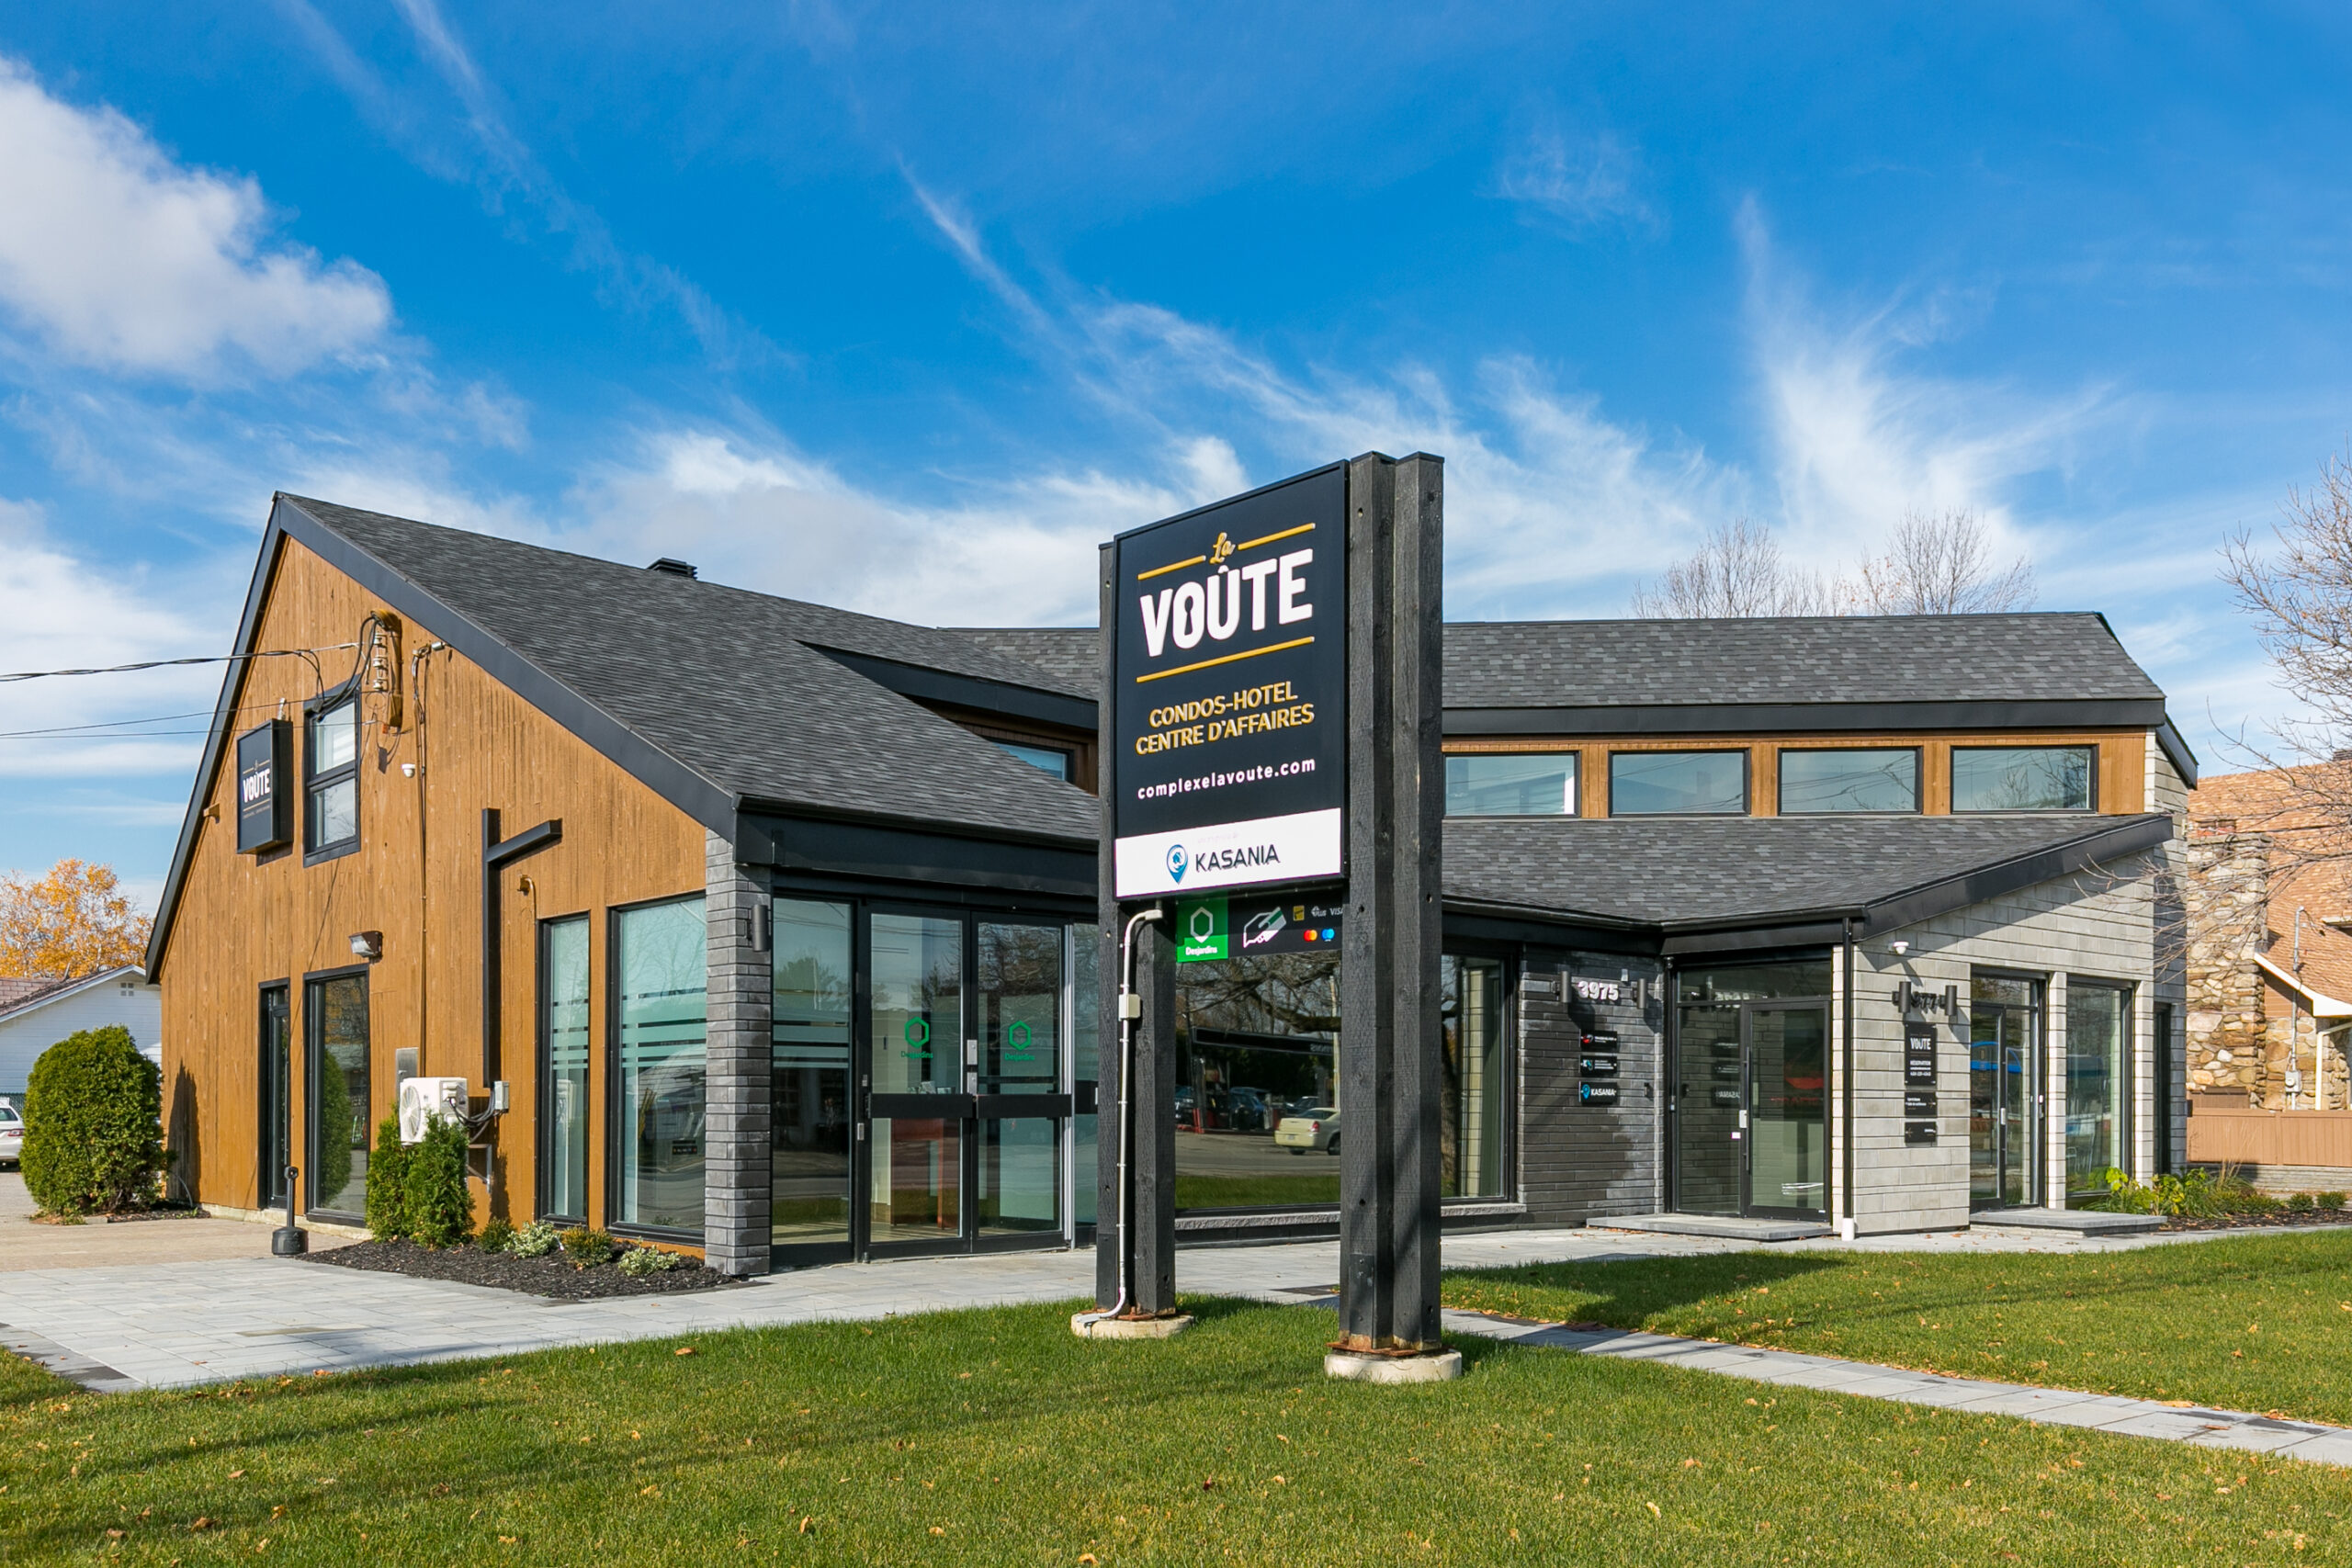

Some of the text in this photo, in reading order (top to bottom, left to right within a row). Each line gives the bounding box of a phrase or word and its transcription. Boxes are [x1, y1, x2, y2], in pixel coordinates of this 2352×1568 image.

[1209, 532, 1236, 564] La
[1139, 547, 1313, 657] VOÛTE
[1149, 681, 1298, 728] CONDOS-HOTEL
[1136, 704, 1315, 755] CENTRE D'AFFAIRES
[1137, 758, 1316, 800] complexelavoute.com
[1195, 844, 1280, 873] KASANIA
[1185, 945, 1218, 956] Desjardins
[1577, 980, 1619, 1001] 3975
[900, 1050, 933, 1060] Desjardins
[1004, 1052, 1035, 1062] Desjardins
[1590, 1088, 1615, 1097] KASANIA
